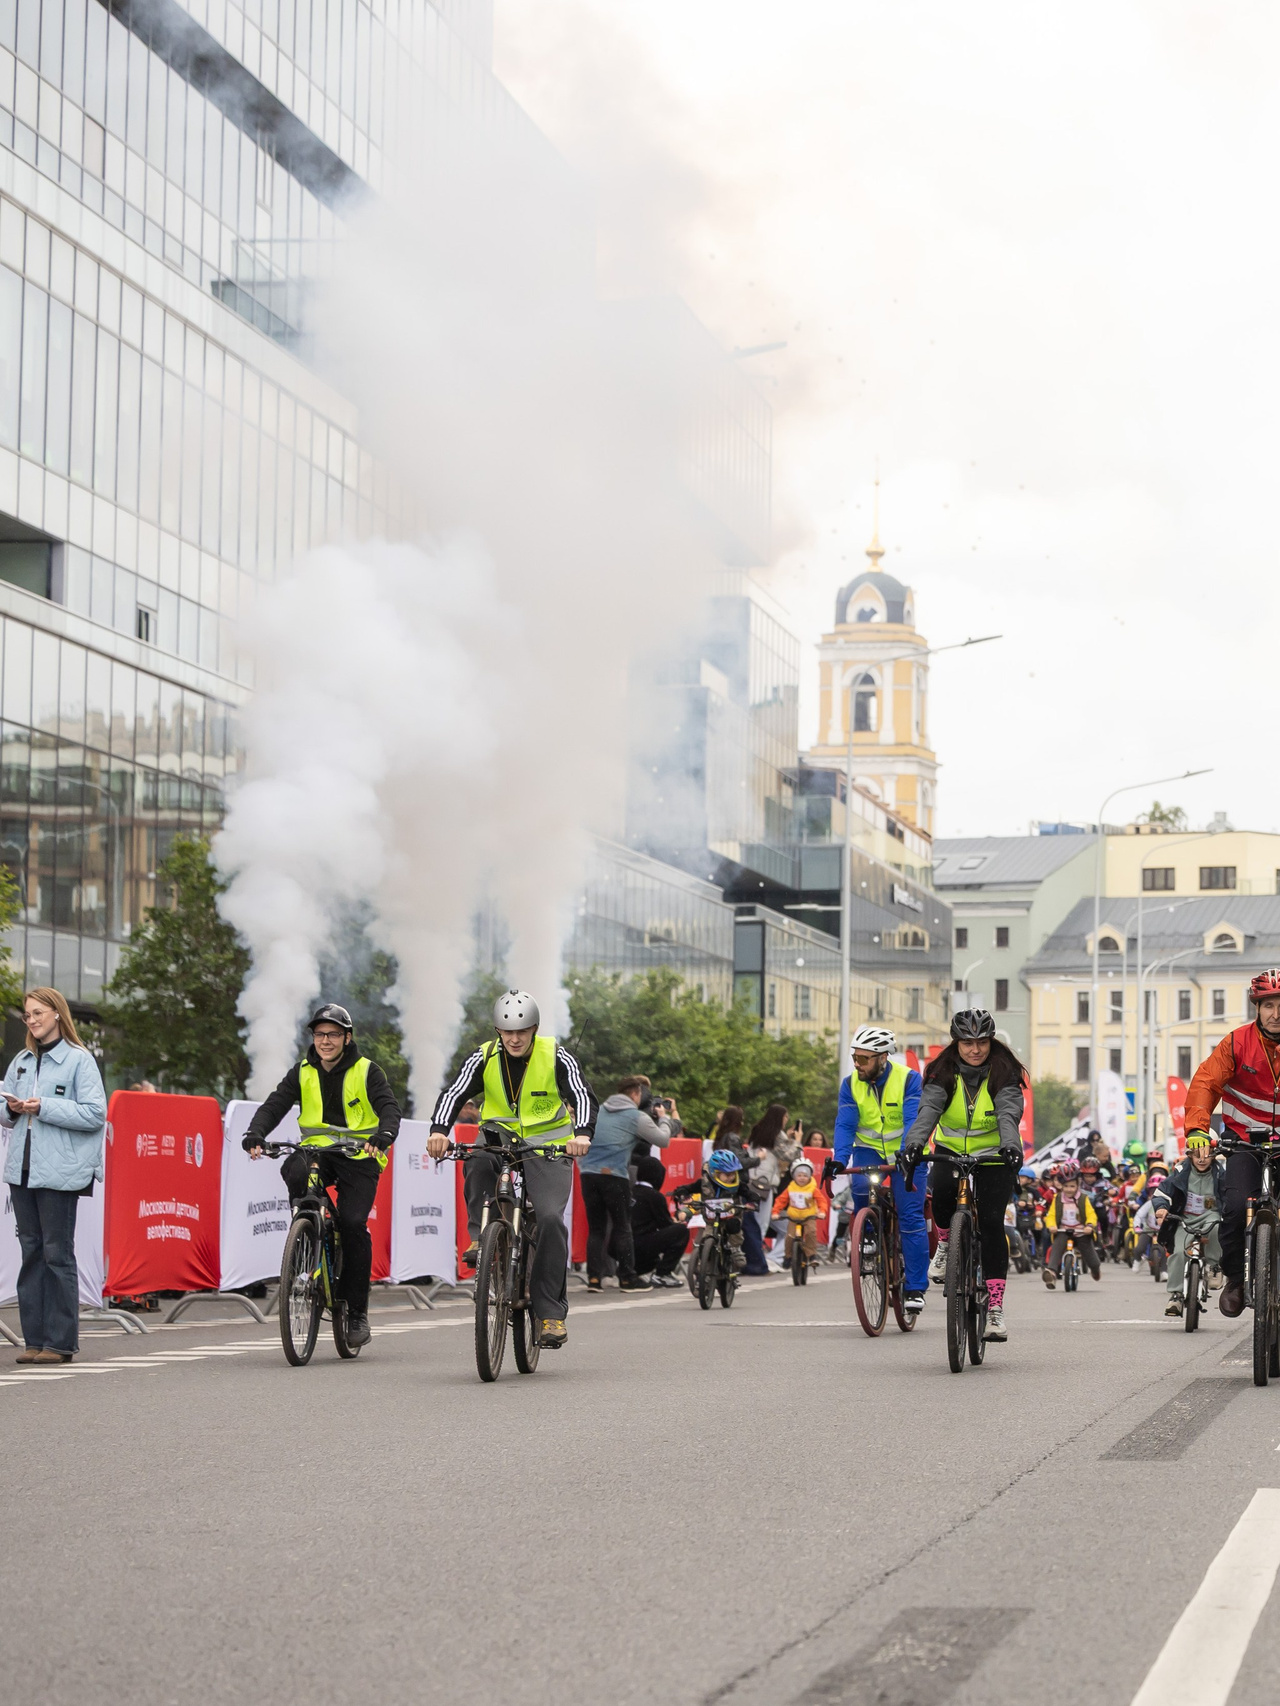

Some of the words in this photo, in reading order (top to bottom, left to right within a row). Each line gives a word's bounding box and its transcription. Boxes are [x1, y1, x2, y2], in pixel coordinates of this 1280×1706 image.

[139, 1197, 176, 1218] Московский
[176, 1201, 200, 1221] детский
[147, 1219, 191, 1242] велофестиваль
